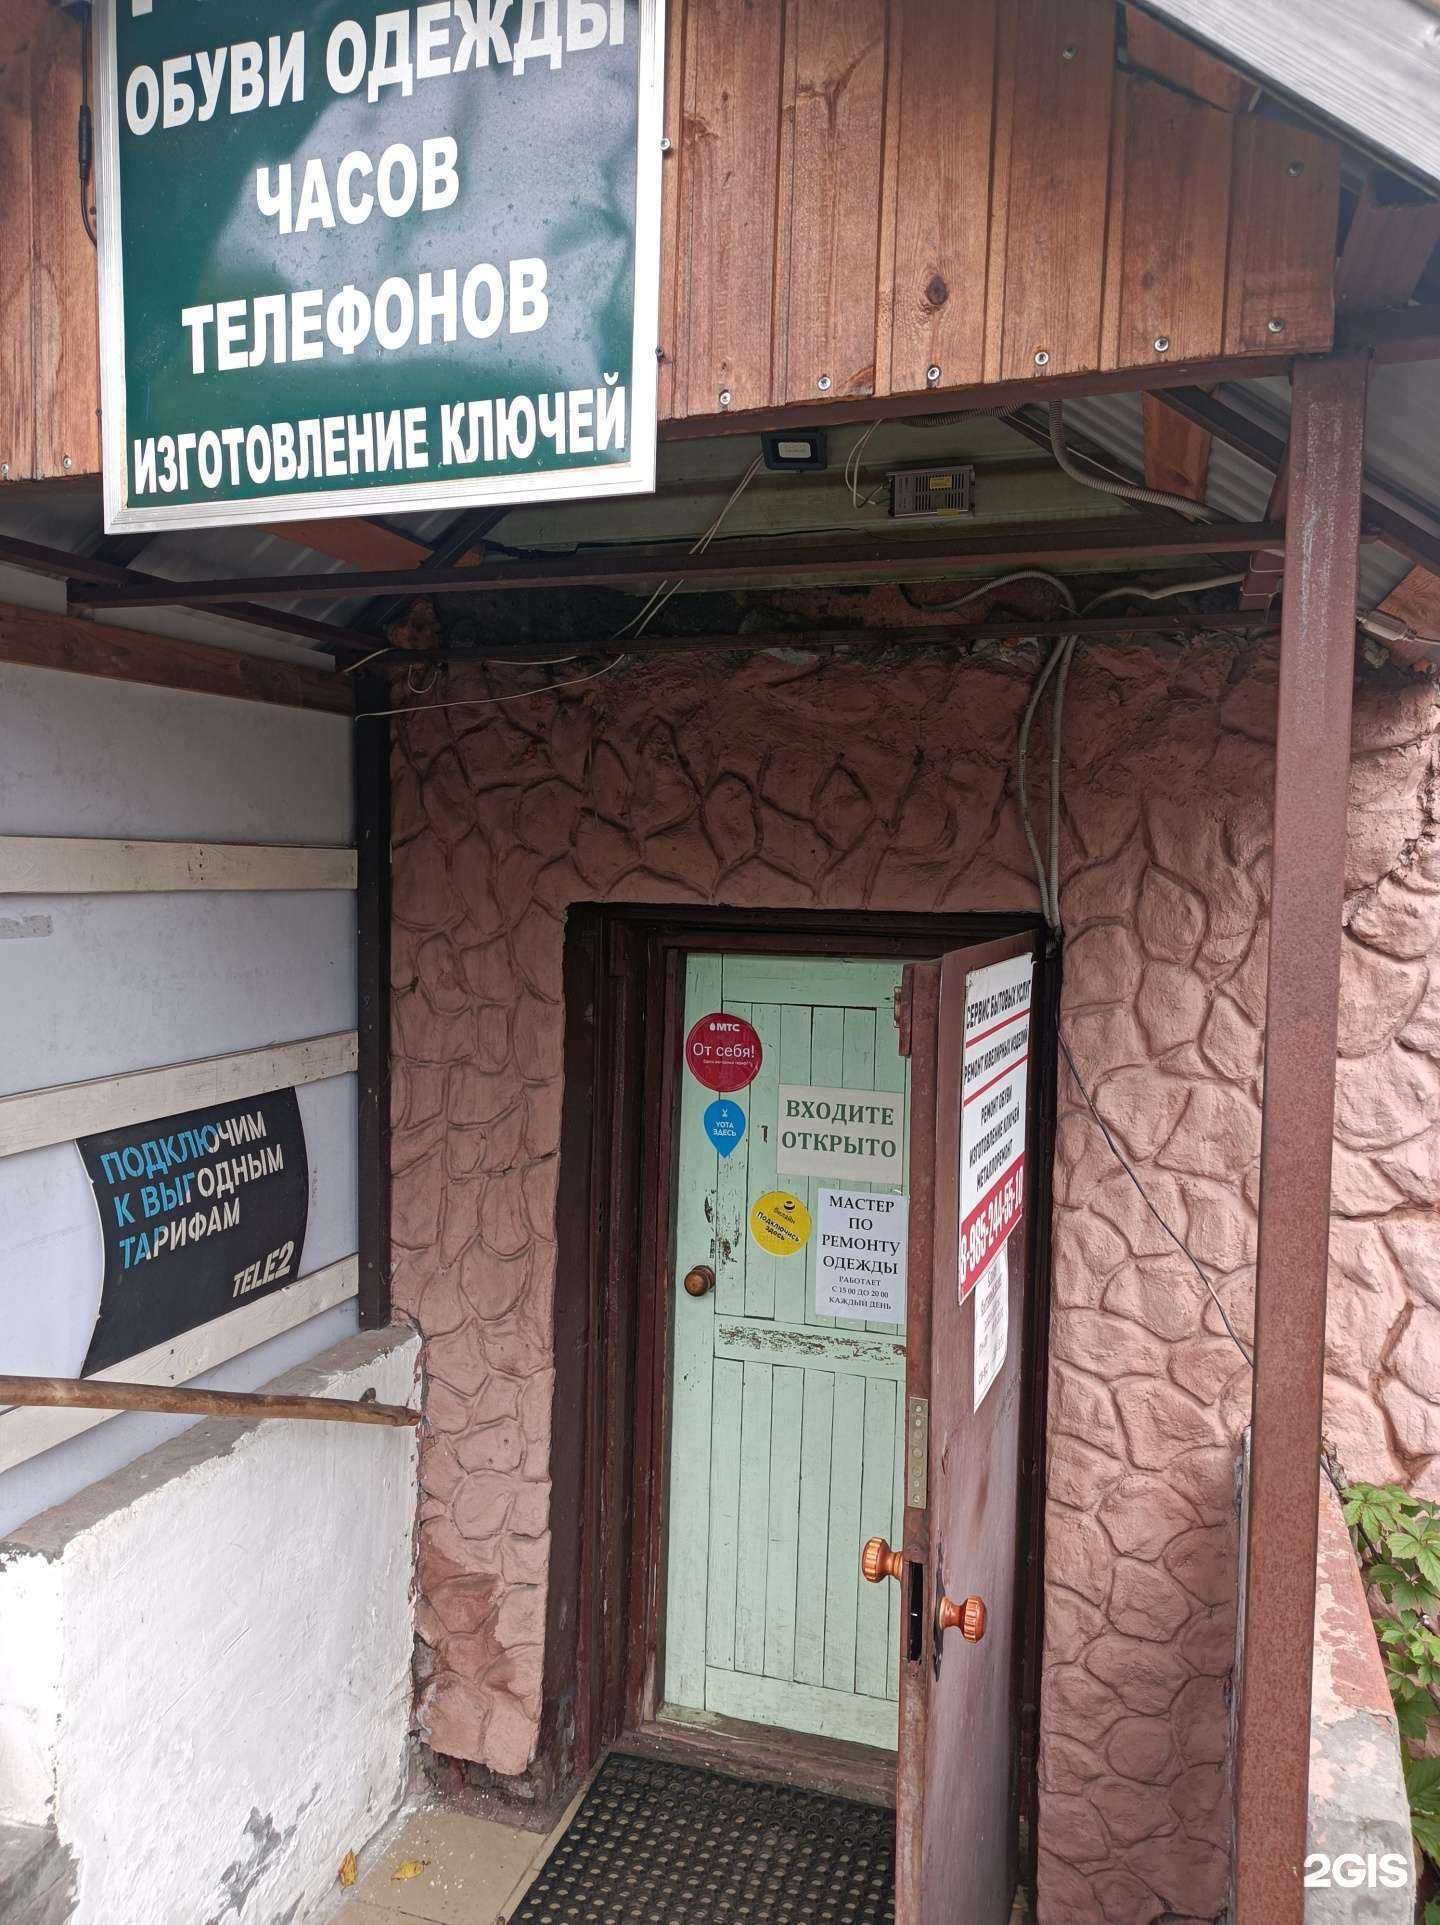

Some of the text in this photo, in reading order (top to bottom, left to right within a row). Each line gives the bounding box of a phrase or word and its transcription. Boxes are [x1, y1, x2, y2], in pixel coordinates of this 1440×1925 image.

[126, 0, 624, 135] ОБУВИ ОДЕЖДЫ
[256, 136, 459, 234] ЧАСОВ
[181, 257, 549, 375] ТЕЛЕФОНОВ
[134, 372, 625, 494] ИЗГОТОВЛЕНИЕ КЛЮЧЕЙ
[966, 998, 990, 1029] СЕРВИС
[717, 1023, 740, 1031] МТС
[693, 1043, 754, 1058] От себя!
[786, 1100, 894, 1125] ВХОДИТЕ
[712, 1129, 737, 1137] ЗДЕСЬ
[782, 1131, 896, 1157] ОТКРЫТО
[100, 1111, 267, 1185] ПОДКЛЮЧИМ
[113, 1144, 284, 1227] К ВЫГОДНЫМ
[829, 1195, 895, 1213] МАСТЕР
[119, 1197, 241, 1269] ТАРИФАМ
[757, 1211, 800, 1242] Подключись
[849, 1217, 873, 1230] ПО
[822, 1234, 901, 1257] РЕМОНТУ
[232, 1241, 294, 1298] TELE2
[823, 1255, 898, 1275] ОДЕЖДЫ
[831, 1285, 838, 1293] С
[839, 1275, 881, 1287] РАБОТАЕТ
[869, 1302, 892, 1310] ДЕНЬ
